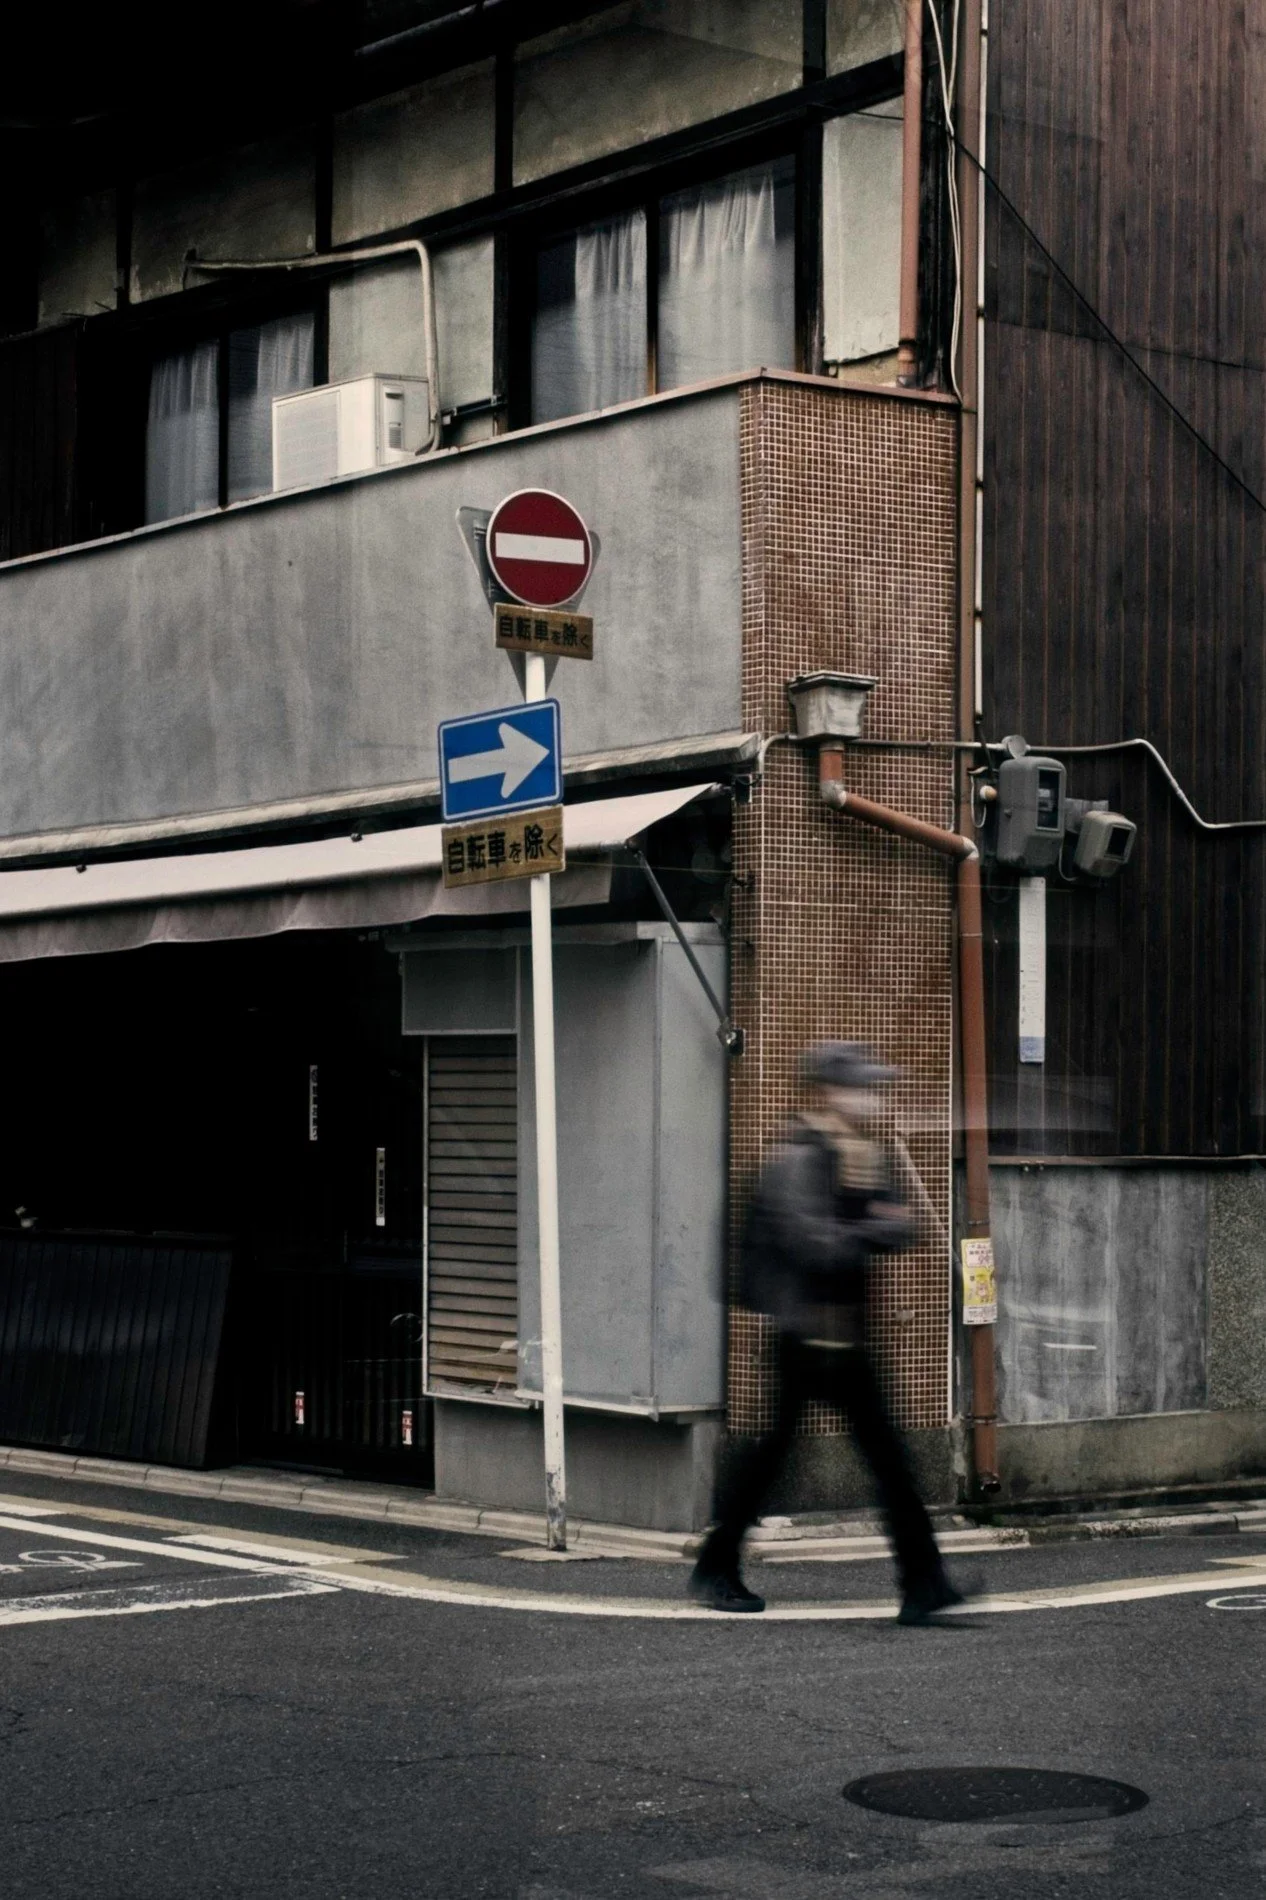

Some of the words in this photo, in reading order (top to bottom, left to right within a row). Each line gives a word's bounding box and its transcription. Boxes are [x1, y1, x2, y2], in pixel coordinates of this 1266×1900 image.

[500, 614, 590, 649] 自転車を除く
[448, 824, 558, 874] 自転車を除く
